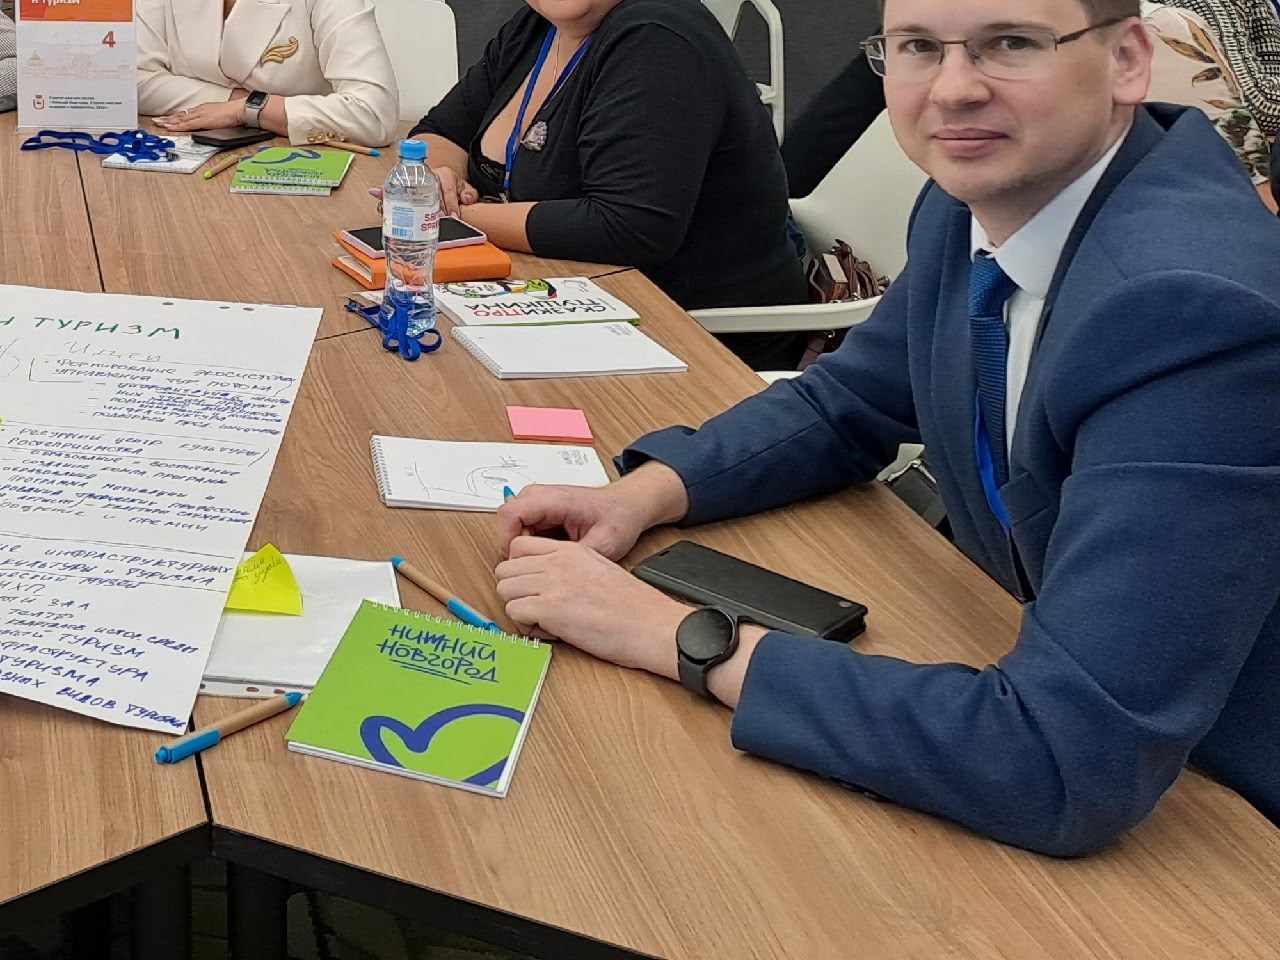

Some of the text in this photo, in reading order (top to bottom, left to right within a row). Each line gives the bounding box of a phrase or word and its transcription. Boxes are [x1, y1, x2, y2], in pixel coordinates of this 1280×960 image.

[101, 30, 116, 48] 4
[463, 297, 601, 311] ПУШКИНА
[33, 316, 181, 340] ТУРИЗМ
[389, 623, 497, 662] НИЖНИЙ
[376, 638, 500, 683] НОВГОРОД
